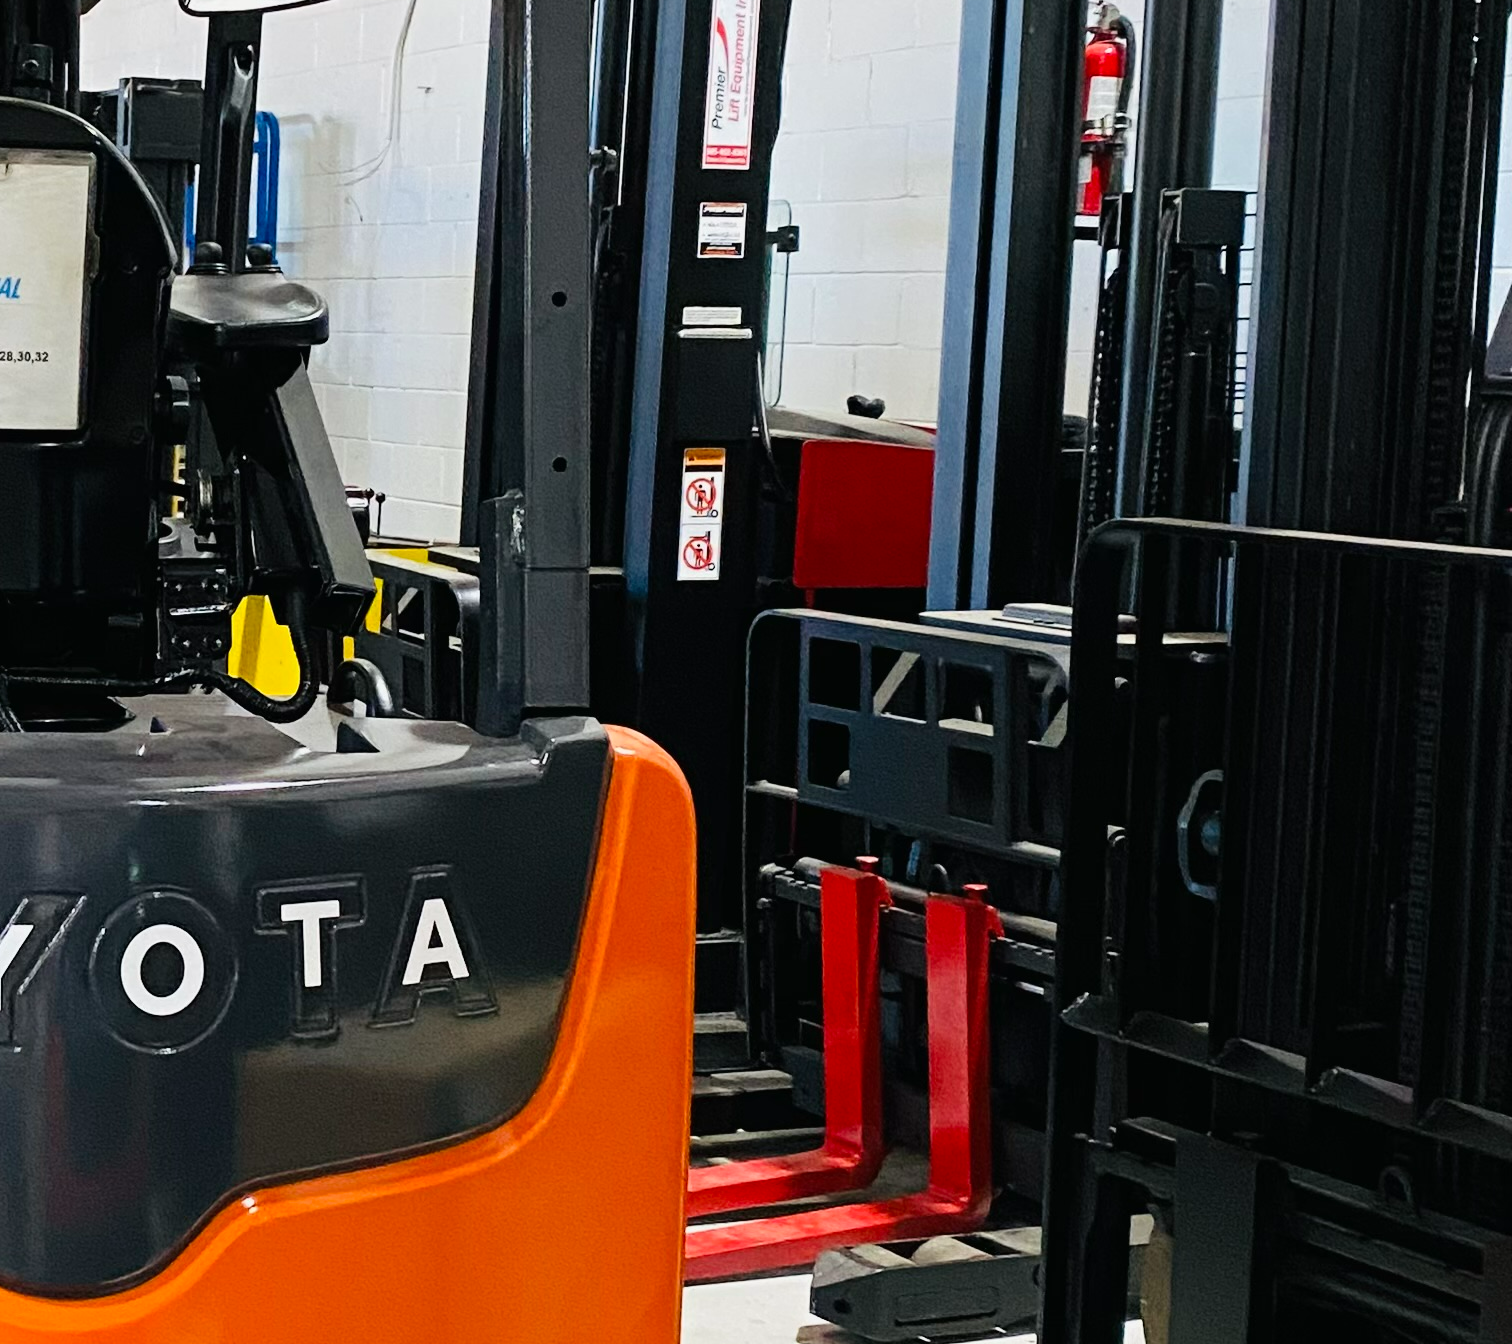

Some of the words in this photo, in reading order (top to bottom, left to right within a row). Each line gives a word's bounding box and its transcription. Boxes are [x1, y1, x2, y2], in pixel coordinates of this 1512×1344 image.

[730, 13, 746, 94] Equipment
[711, 66, 727, 130] Premier
[728, 98, 741, 123] Lift
